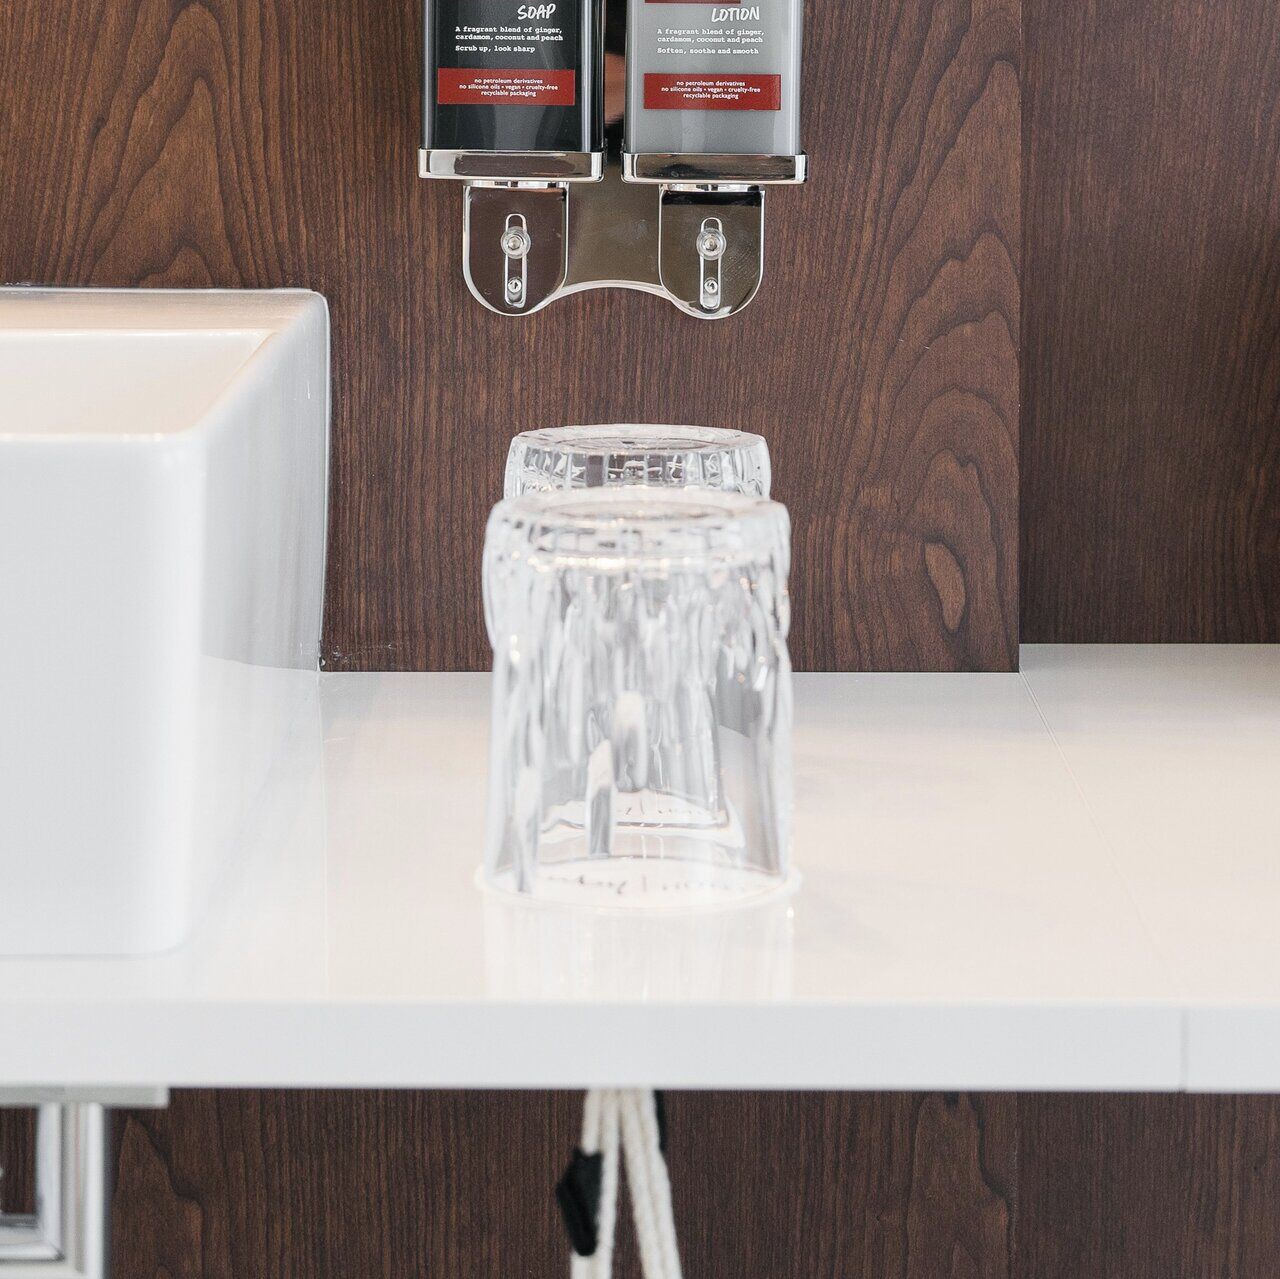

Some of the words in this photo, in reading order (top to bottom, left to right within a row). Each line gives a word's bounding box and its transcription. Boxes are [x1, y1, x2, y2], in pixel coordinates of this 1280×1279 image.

[517, 3, 556, 20] SOAP
[711, 6, 760, 23] LOTION
[462, 26, 498, 34] fragrant
[535, 27, 563, 35] ginger,
[665, 28, 700, 36] fragrant
[737, 29, 765, 37] ginger,
[541, 34, 564, 42] peach
